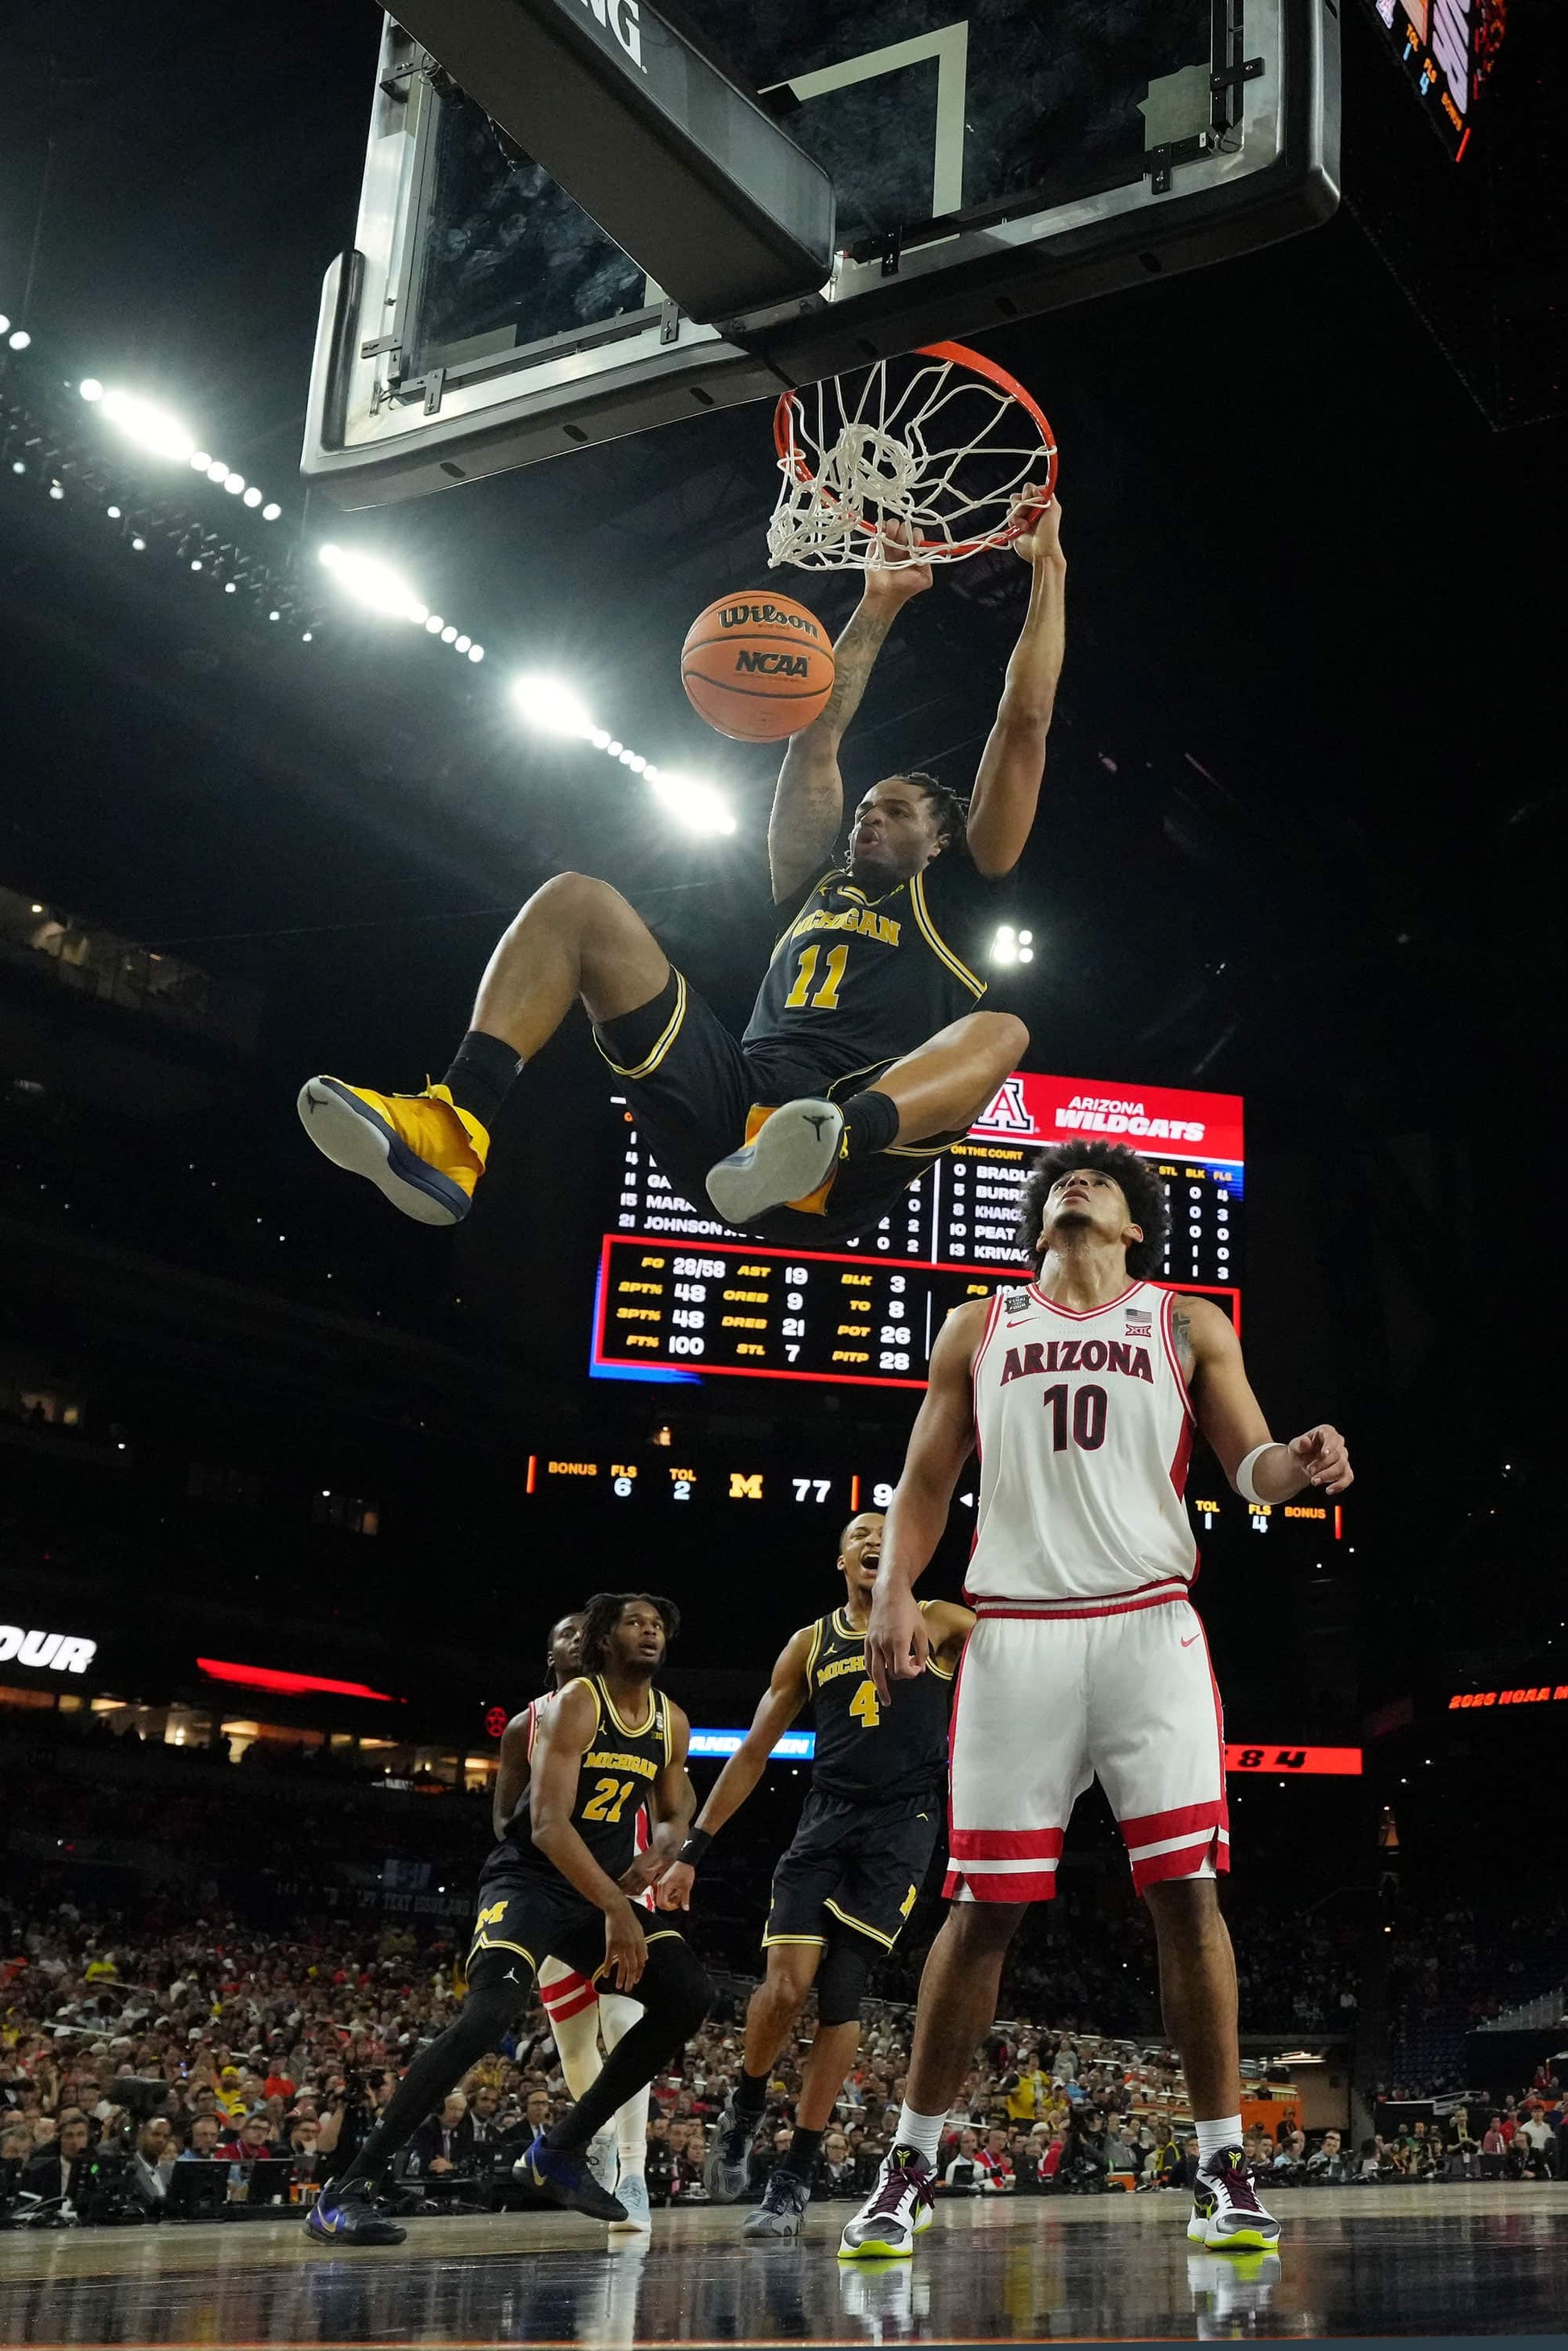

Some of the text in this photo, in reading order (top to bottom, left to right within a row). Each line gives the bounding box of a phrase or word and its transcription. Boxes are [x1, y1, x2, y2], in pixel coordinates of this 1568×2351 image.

[717, 604, 819, 641] Wilson
[735, 650, 808, 678] NCAA
[785, 944, 848, 1010] 11
[1068, 1096, 1144, 1116] ARIZONA
[1055, 1108, 1205, 1142] WILDCATS
[625, 1151, 638, 1165] 4
[951, 1145, 1023, 1160] ON THE COURT
[953, 1163, 967, 1176] 0
[1159, 1166, 1178, 1176] STL
[624, 1172, 637, 1186] 11
[954, 1184, 965, 1196] 5
[1189, 1186, 1201, 1200] 0
[1217, 1189, 1229, 1202] 4
[620, 1192, 637, 1207] 15
[908, 1199, 921, 1212] 0
[953, 1204, 964, 1217] 8
[1189, 1205, 1201, 1219] 0
[1217, 1209, 1229, 1221] 3
[619, 1213, 635, 1228] 21
[644, 1216, 723, 1235] JOHNSON
[908, 1219, 919, 1232] 2
[950, 1223, 1016, 1241] 10 PEAT
[1189, 1225, 1230, 1241] 0 0
[877, 1237, 919, 1252] 0 2
[949, 1243, 965, 1257] 13
[1193, 1245, 1198, 1258] 1
[1217, 1247, 1230, 1260] 0
[641, 1257, 906, 1293] FG 28/58 AST 19 BLK 3
[1193, 1264, 1198, 1277] 1
[1217, 1267, 1229, 1280] 3
[674, 1284, 707, 1303] 48
[723, 1290, 769, 1303] OREB
[786, 1293, 803, 1310] 9
[850, 1300, 871, 1311] TO
[889, 1301, 905, 1318] 8
[672, 1310, 704, 1329] 48
[721, 1316, 768, 1329] DREB
[782, 1319, 805, 1337] 21
[837, 1325, 870, 1337] POT
[881, 1326, 911, 1345] 26
[1126, 1325, 1151, 1337] XII
[626, 1335, 910, 1370] FT% 100 STL 7 PITP 28
[1000, 1340, 1154, 1387] ARIZONA
[1043, 1384, 1108, 1452] 10
[549, 1462, 597, 1476] BONUS
[611, 1465, 637, 1478] FLS
[669, 1468, 696, 1481] TOL
[614, 1478, 632, 1497] 6
[674, 1481, 691, 1500] 2
[729, 1473, 831, 1503] M 77
[873, 1484, 895, 1507] 9
[1196, 1500, 1220, 1512] TOL
[1249, 1504, 1271, 1516] FLS
[1285, 1507, 1326, 1519] BONUS
[1205, 1512, 1212, 1529] 1
[1252, 1516, 1267, 1533] 4
[817, 1656, 865, 1687] MICH
[849, 1681, 879, 1727] 4
[1449, 1693, 1497, 1709] 2026
[1498, 1687, 1550, 1704] NCAA
[583, 1752, 657, 1781] MICHIGAN
[1238, 1750, 1306, 1768] 8 4
[582, 1778, 634, 1822] 21
[475, 1900, 509, 1934] M
